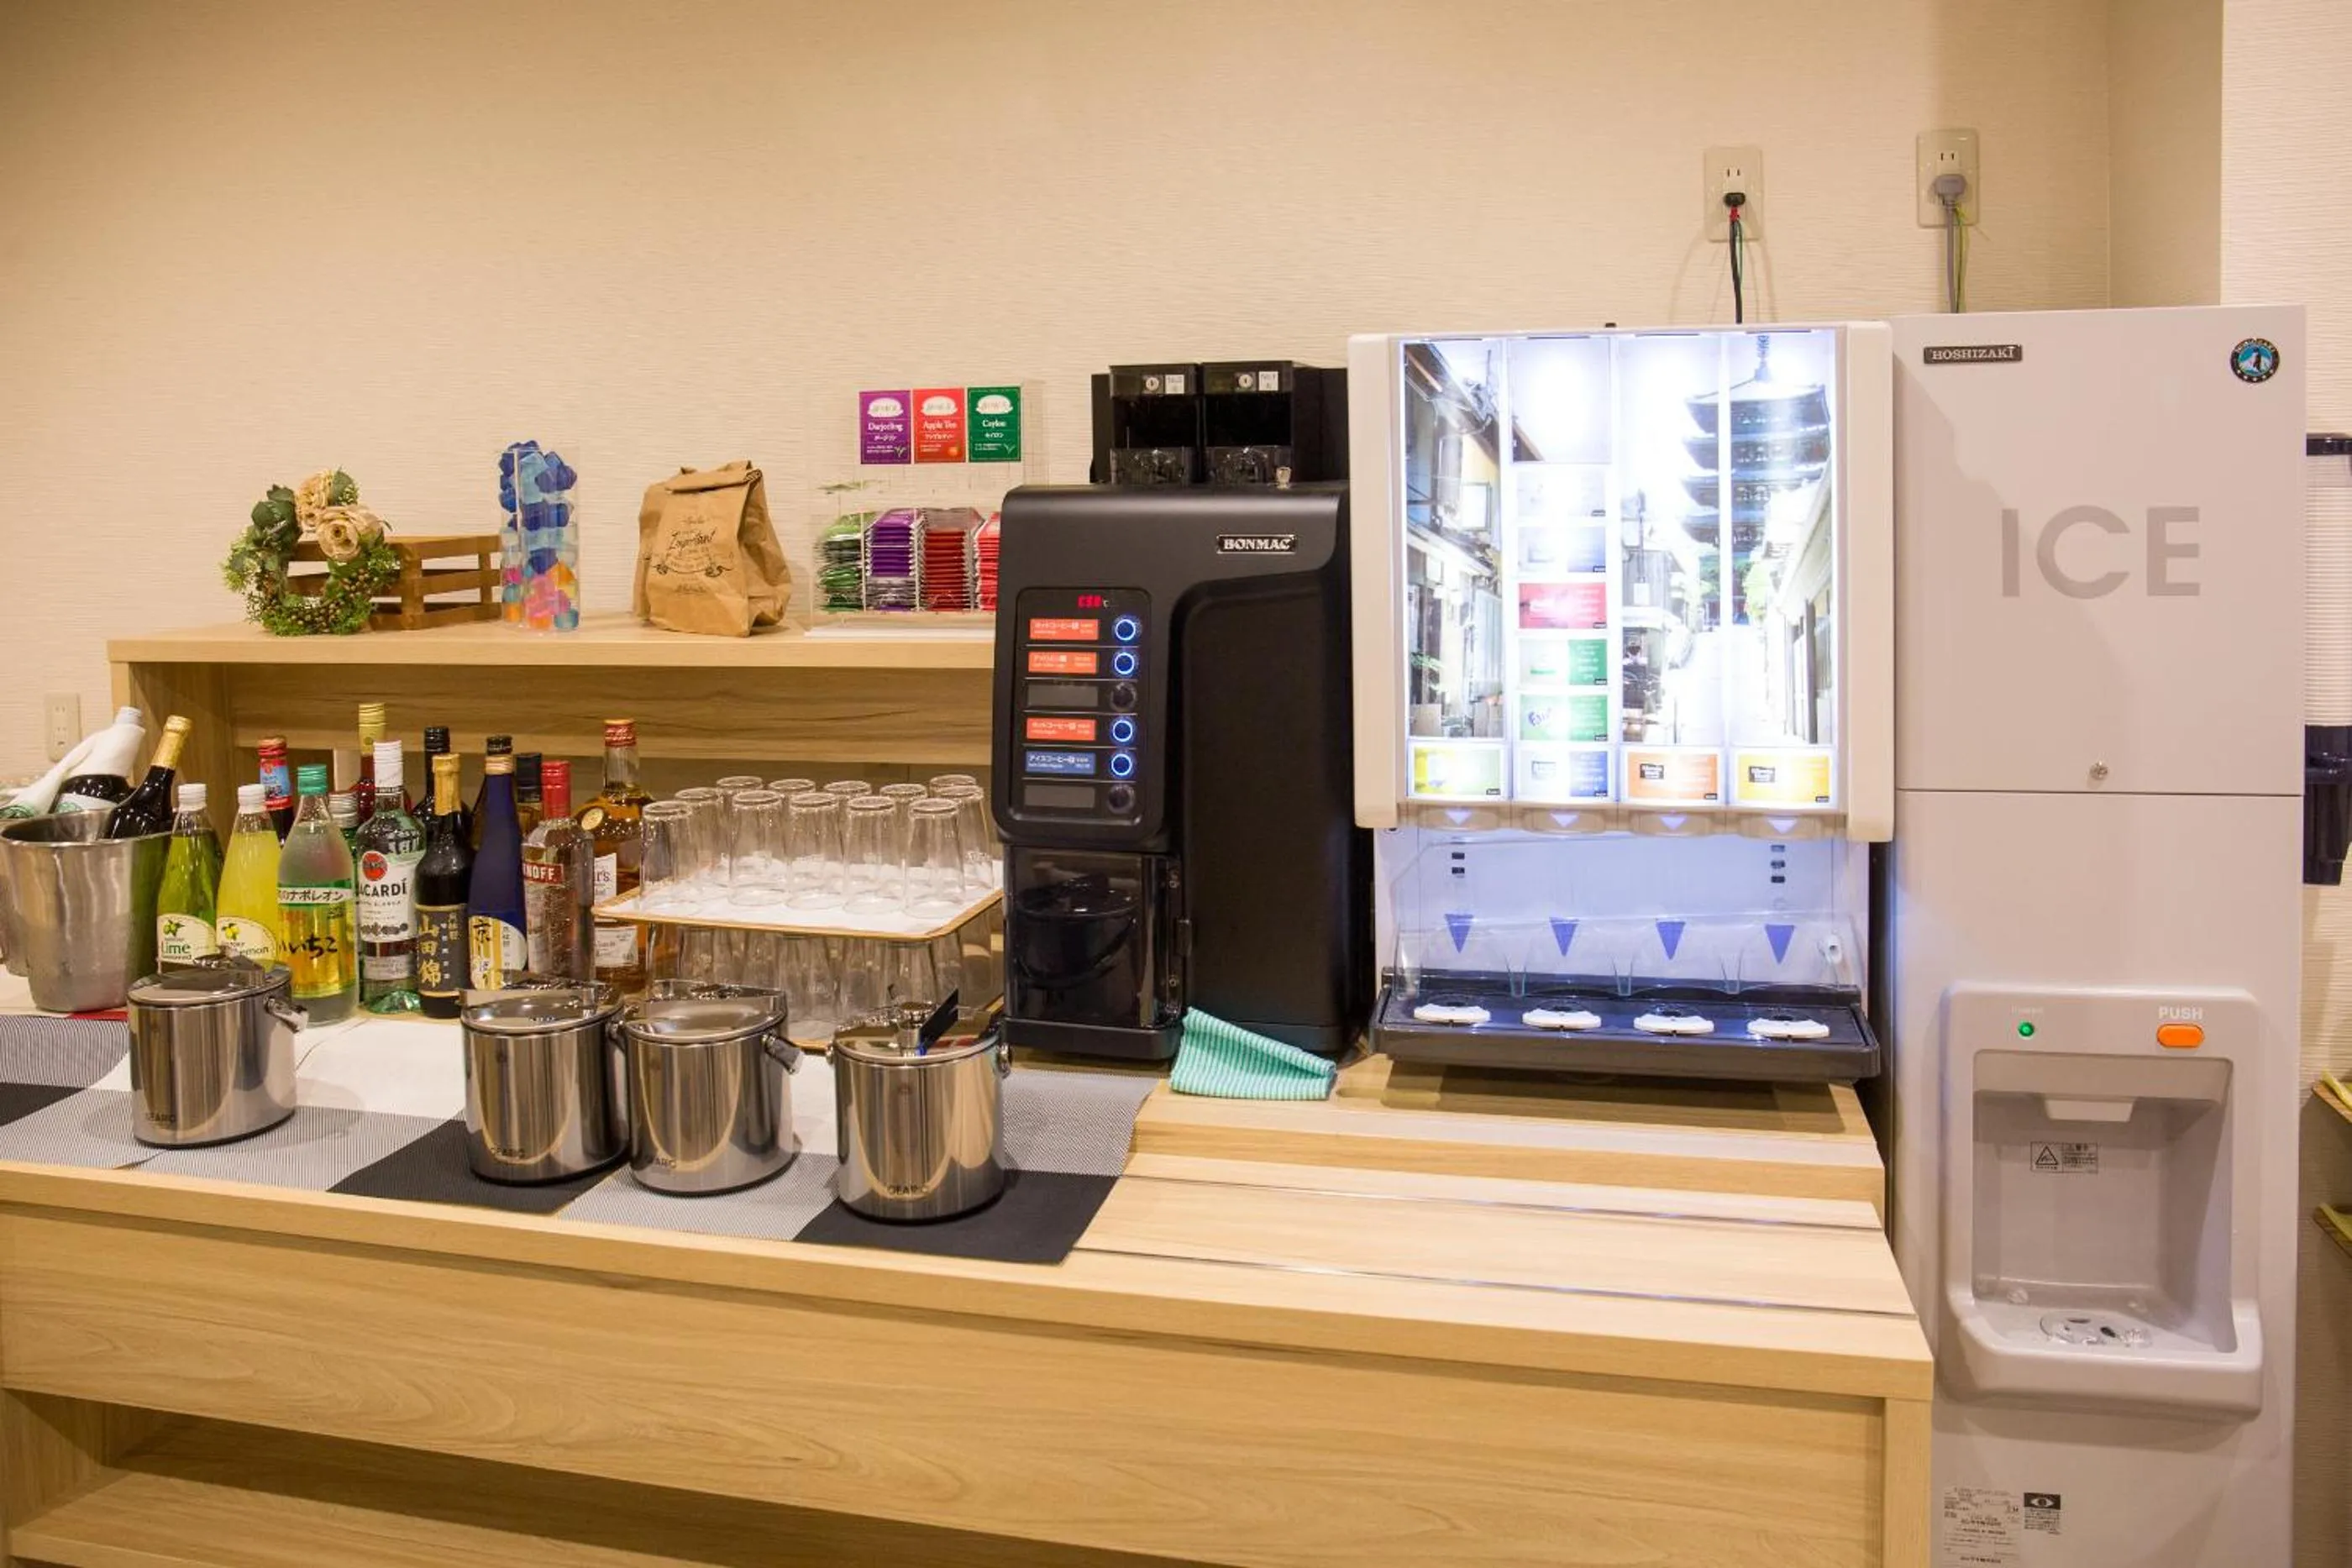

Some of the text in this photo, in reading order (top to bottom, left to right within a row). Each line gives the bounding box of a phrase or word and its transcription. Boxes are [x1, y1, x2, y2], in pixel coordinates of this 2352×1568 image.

[1932, 347, 2014, 359] HOSHIZAKI
[1224, 538, 1291, 550] BONMAC
[2002, 505, 2201, 599] ICE
[358, 878, 407, 897] ACARDÍ
[276, 889, 344, 901] のナポレオン
[160, 940, 192, 954] Lime
[2158, 1006, 2203, 1020] PUSH
